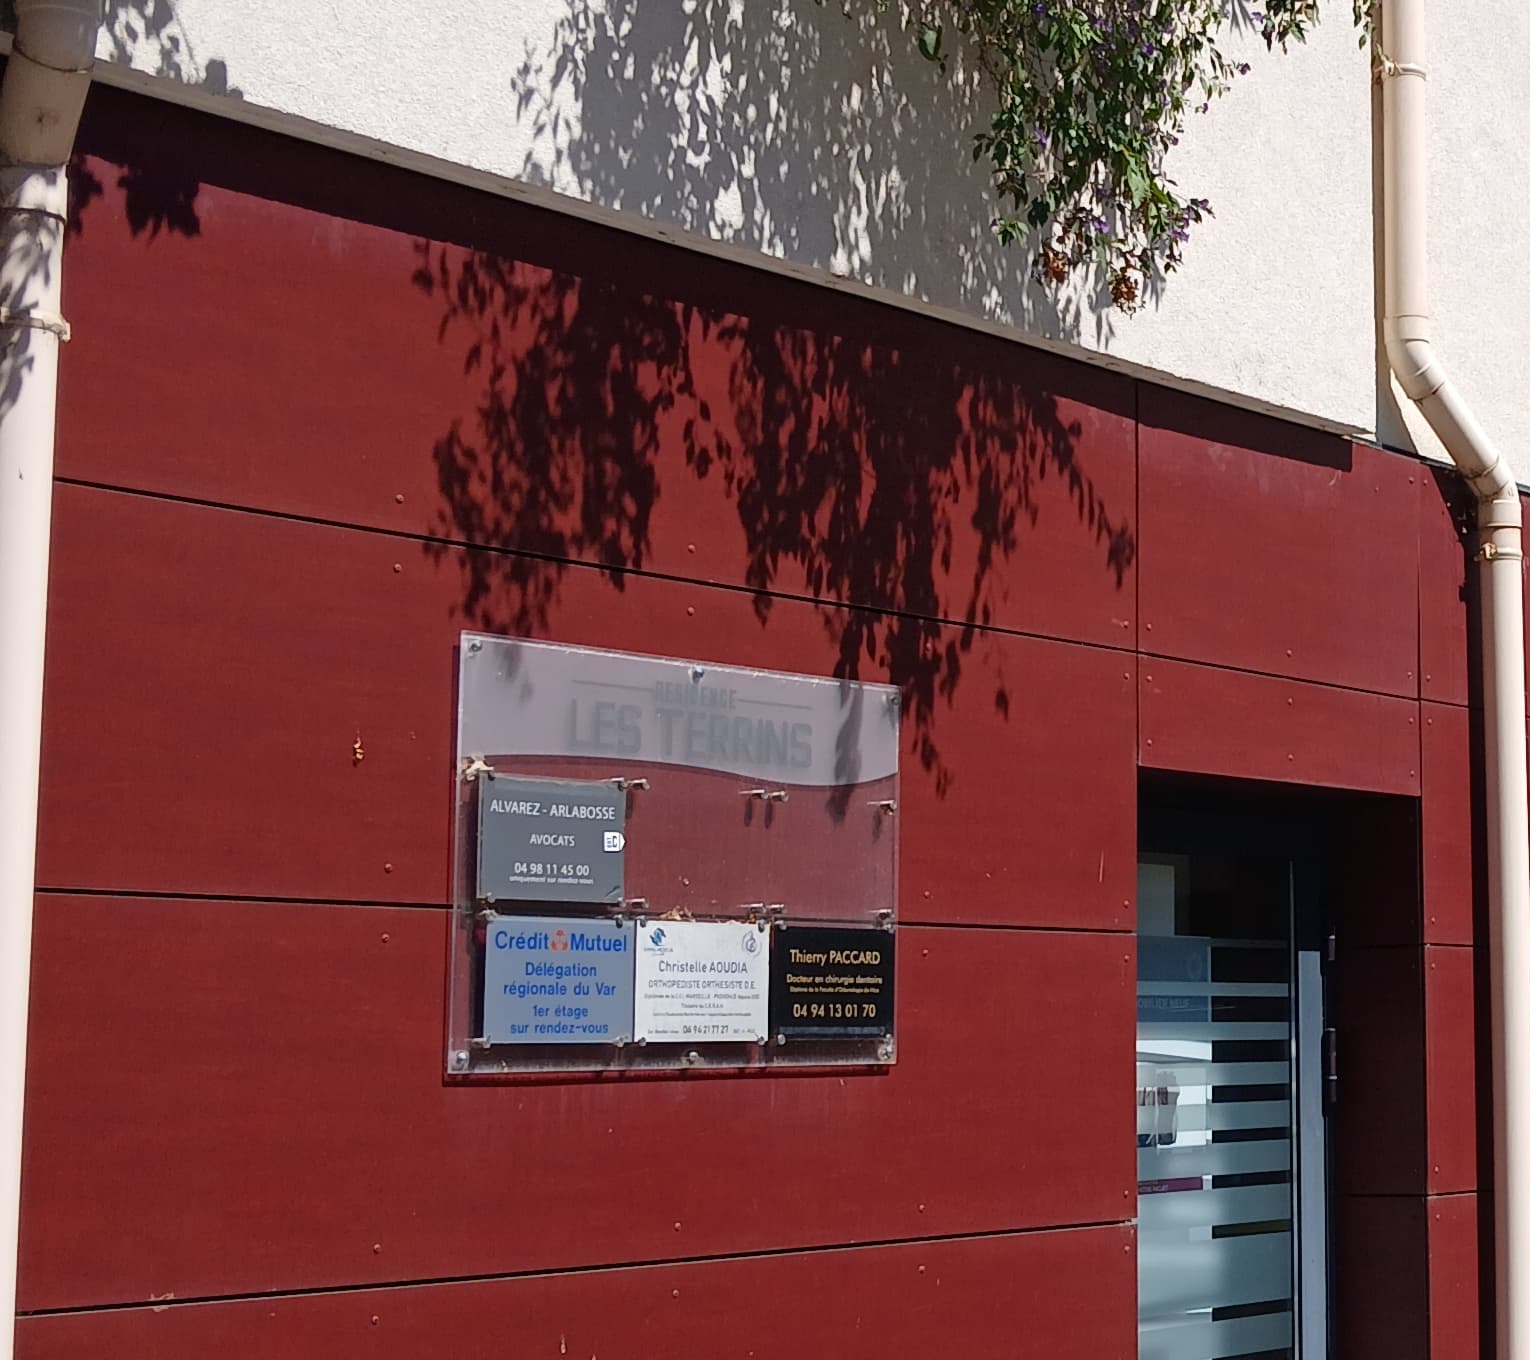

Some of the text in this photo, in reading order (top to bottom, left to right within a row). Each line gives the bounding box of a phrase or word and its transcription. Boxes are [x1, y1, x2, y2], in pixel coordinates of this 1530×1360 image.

[565, 698, 813, 769] LES TERRINS
[490, 799, 541, 816] ALVAREZ
[550, 804, 616, 820] ARLABOSSE
[529, 833, 576, 847] AVOCATS
[514, 862, 590, 876] 04 98 11 45 00
[494, 930, 628, 953] Crédit Mutuel
[789, 949, 881, 967] Thierry PACCARD
[525, 961, 597, 979] Délégation
[658, 960, 749, 974] Christelle AOUDIA
[786, 974, 813, 984] Docteur
[814, 975, 824, 984] en
[503, 981, 617, 999] régionale du Var
[533, 1004, 589, 1020] 1er étage
[793, 1003, 877, 1018] 04 94 13 01 70
[510, 1021, 609, 1035] sur rendez-vous
[682, 1025, 692, 1034] 04
